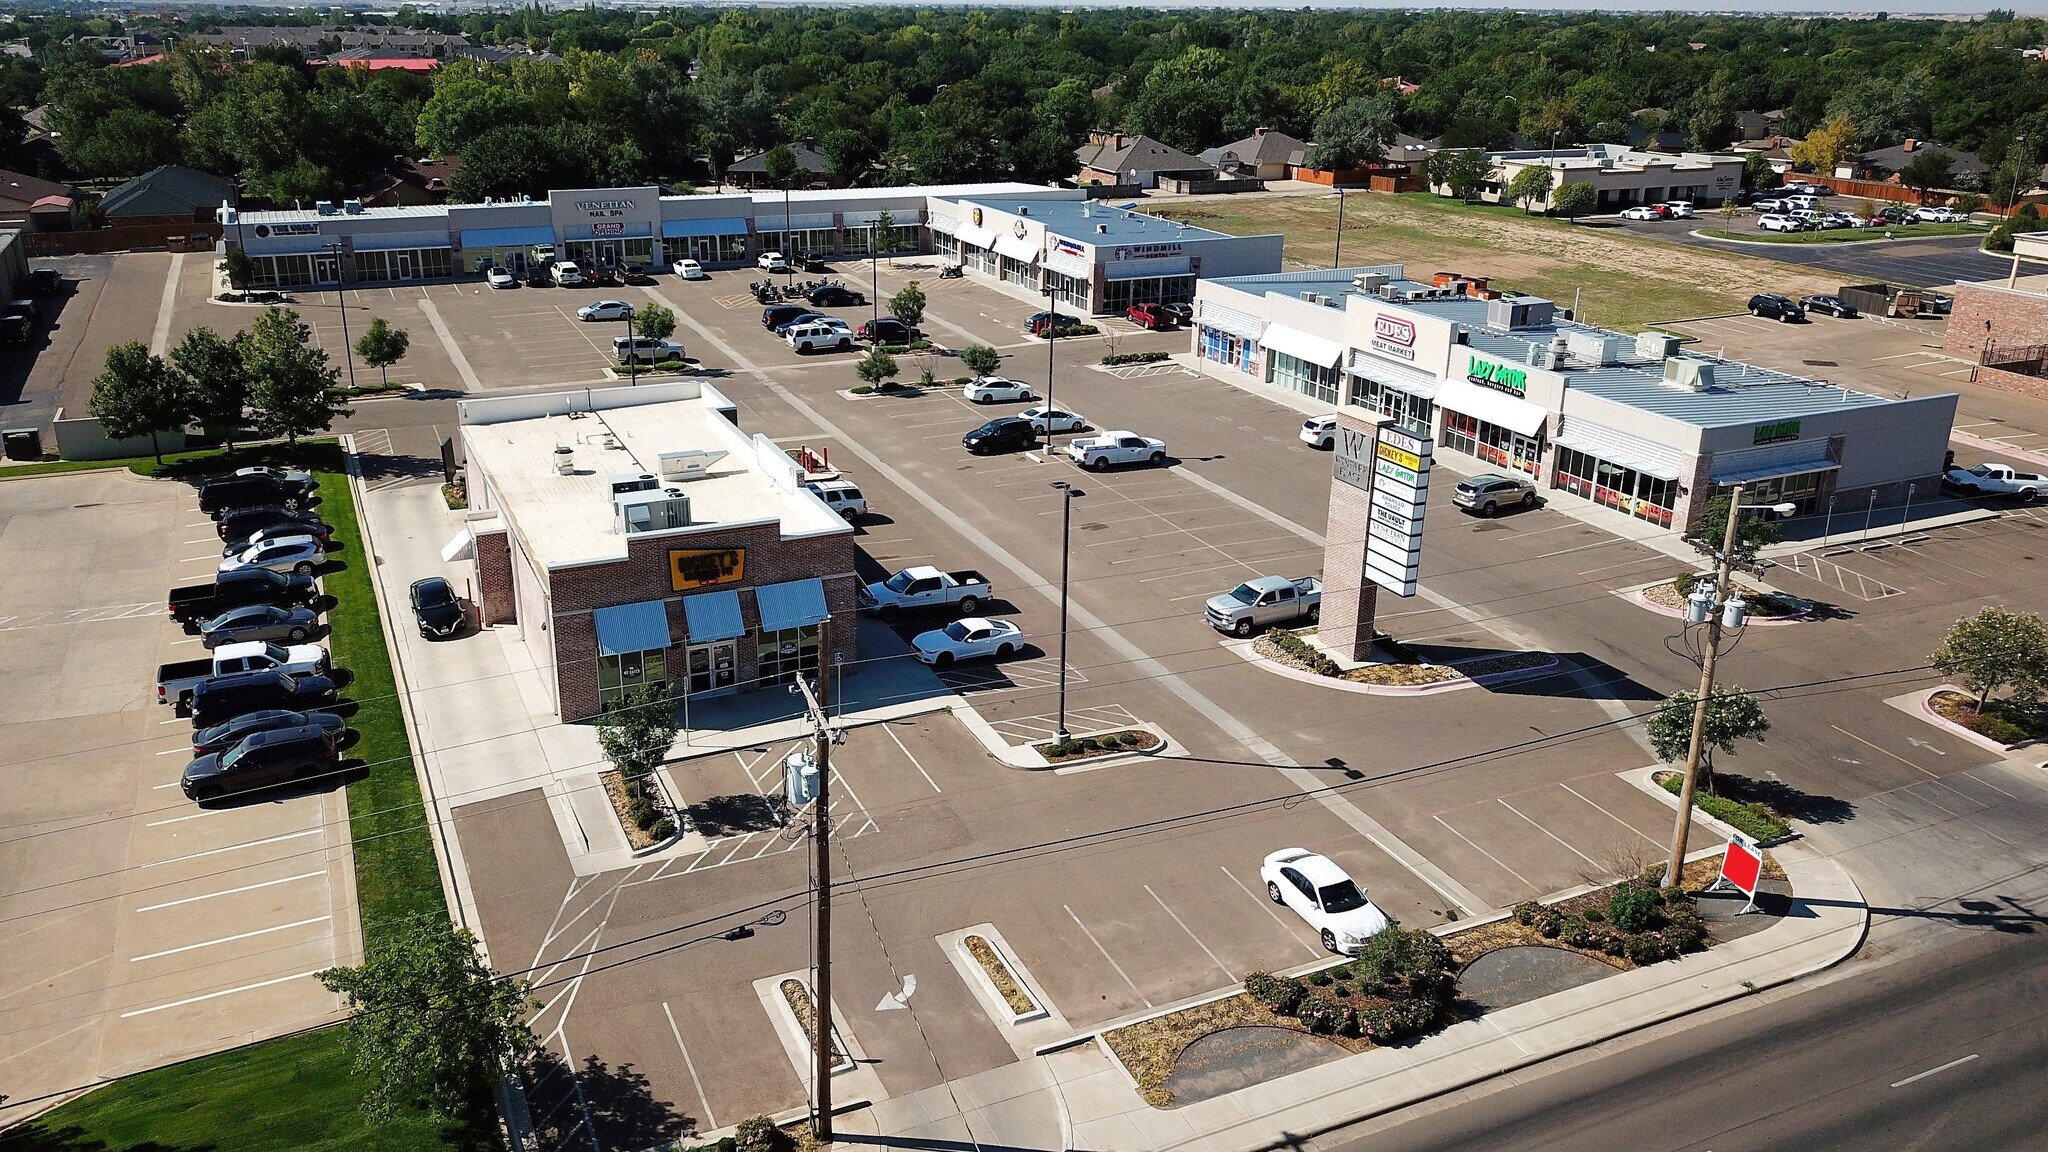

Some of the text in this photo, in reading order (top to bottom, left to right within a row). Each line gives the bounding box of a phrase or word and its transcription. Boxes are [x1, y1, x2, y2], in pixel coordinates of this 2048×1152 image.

[575, 200, 635, 211] VENETIAN
[1133, 244, 1182, 253] WINDMILL
[1376, 318, 1411, 341] EDES
[1371, 340, 1411, 357] MEAT MARKET
[1469, 355, 1527, 392] LAZY GATOR
[1342, 427, 1366, 459] W
[1386, 430, 1414, 450] EDES
[1379, 445, 1403, 462] DICKEY'S
[1378, 461, 1415, 484] LAZY GATOR
[1382, 494, 1405, 507] AMARILLO
[1385, 501, 1400, 511] POLICE
[1377, 508, 1388, 518] THE
[1388, 513, 1405, 526] VAULT
[1373, 522, 1406, 542] VENETIAN
[1733, 833, 1761, 857] FOR LEASE
